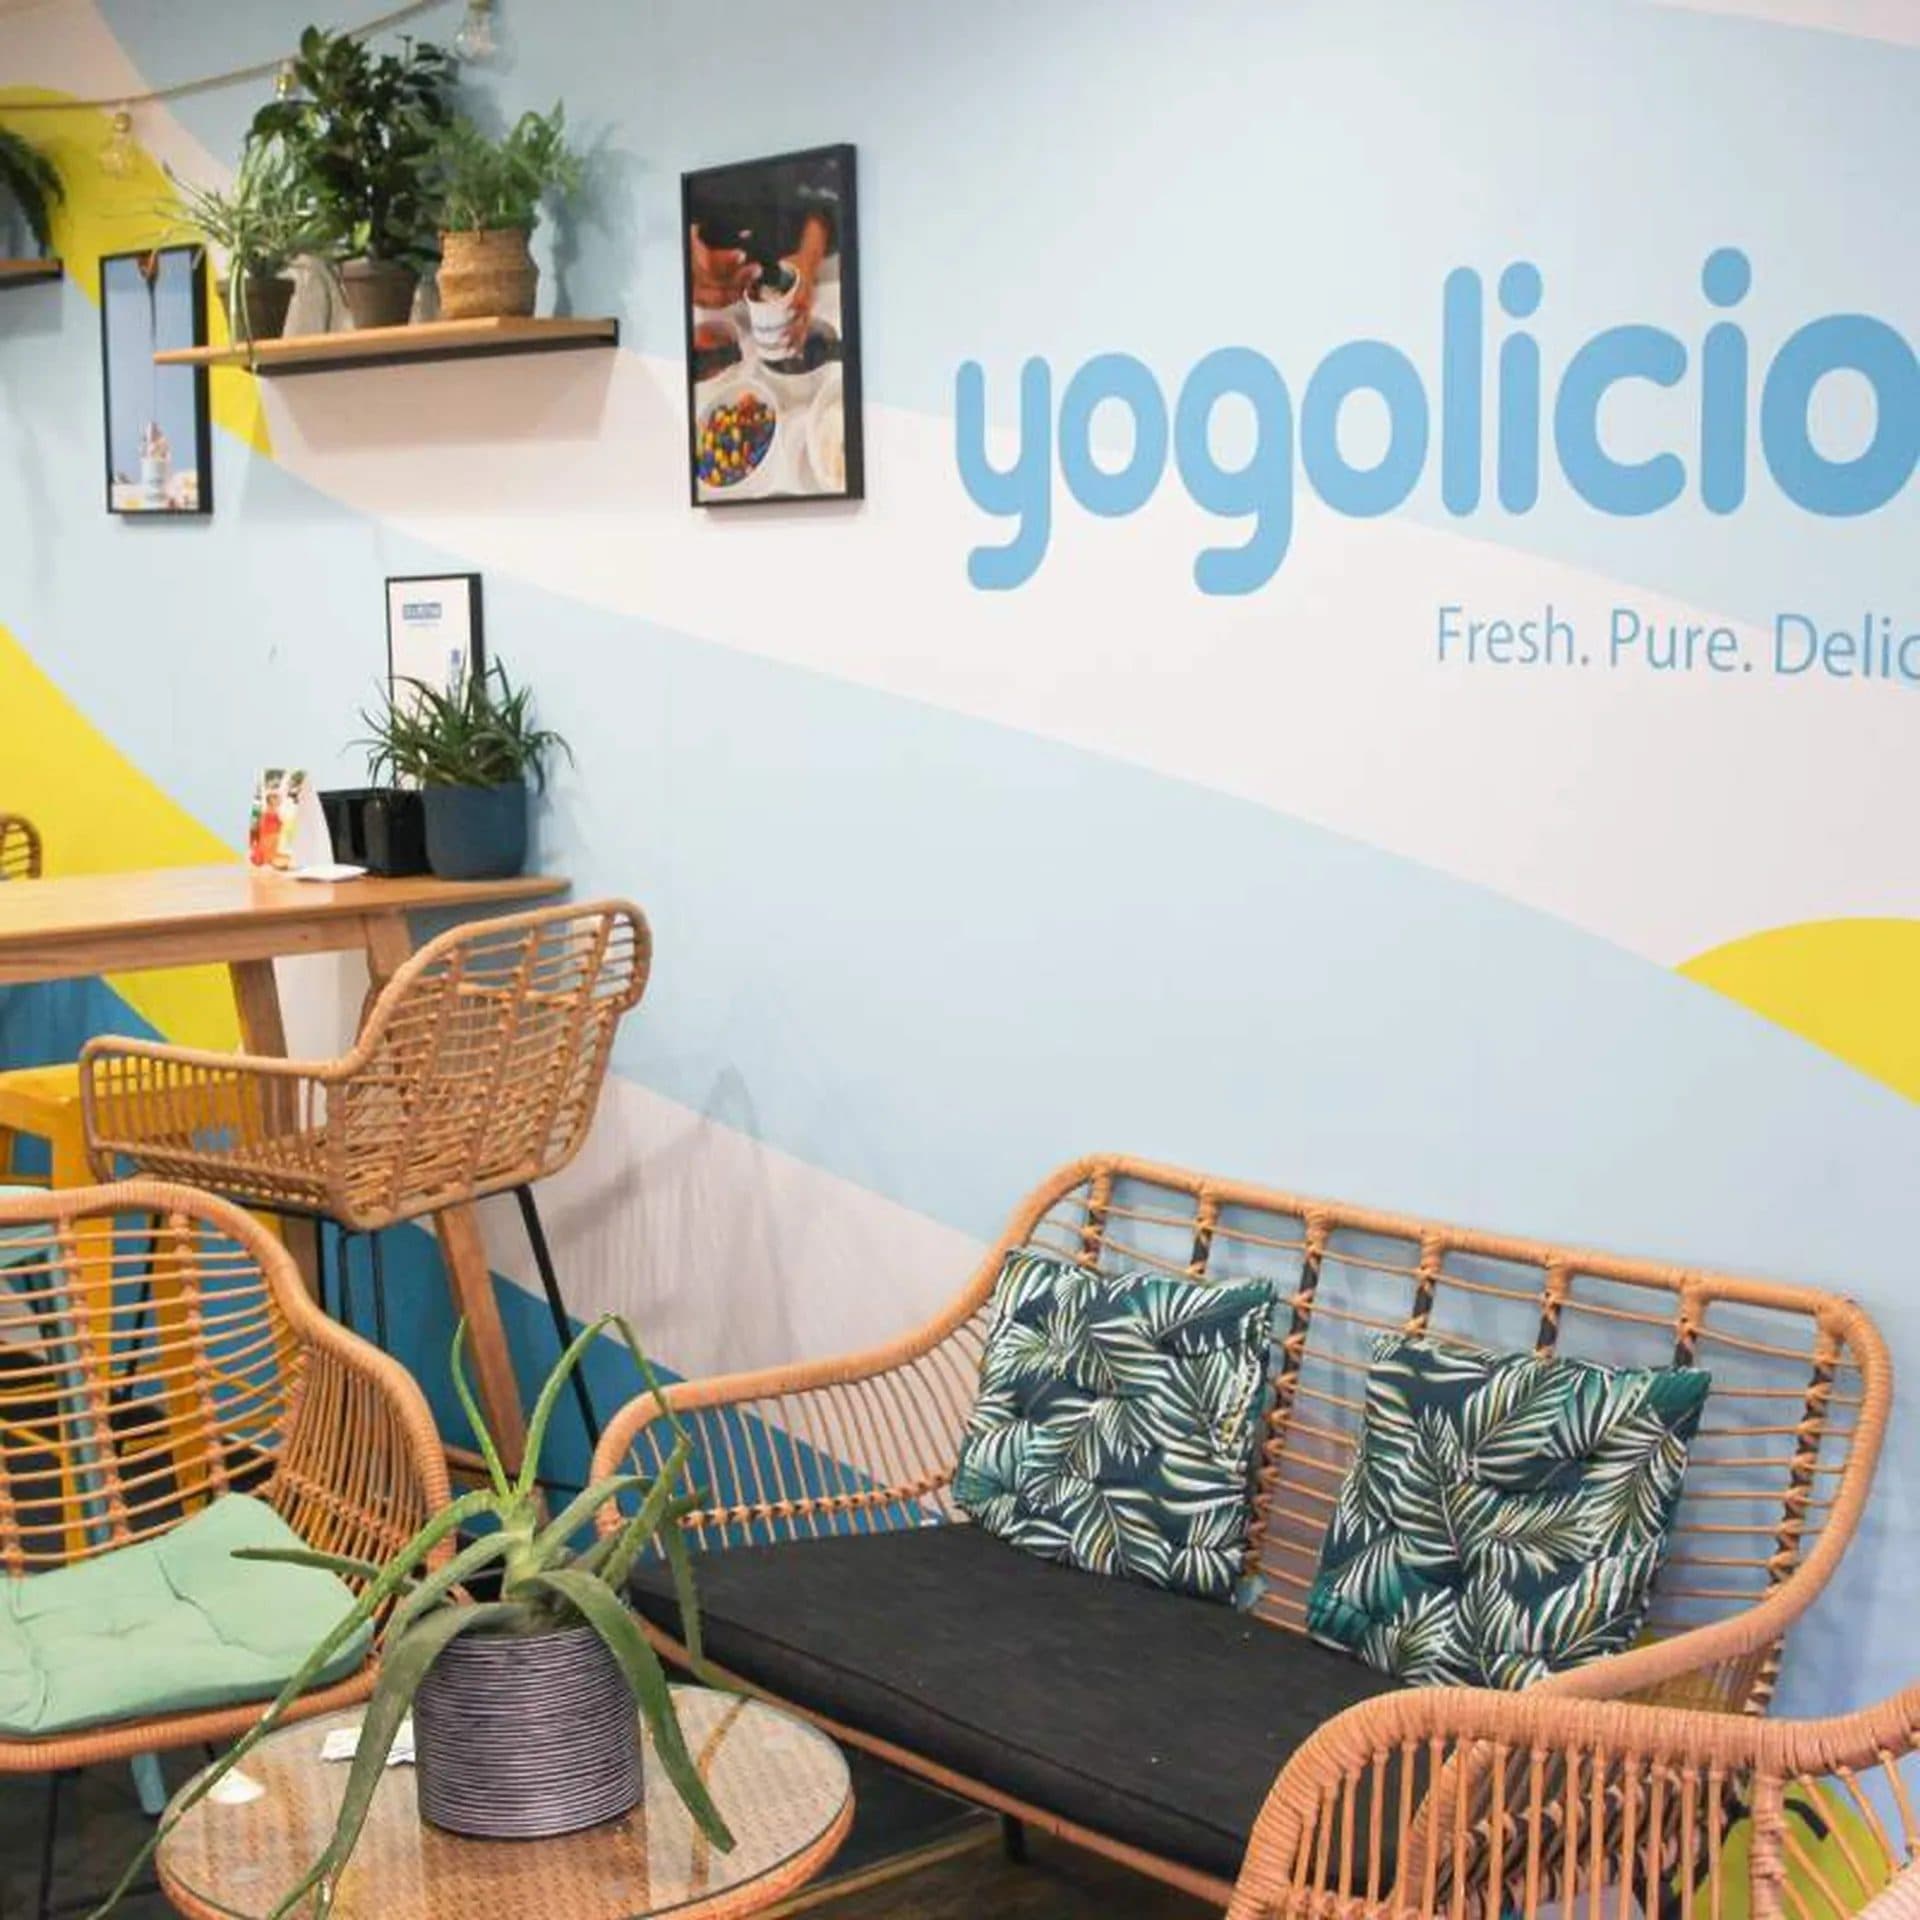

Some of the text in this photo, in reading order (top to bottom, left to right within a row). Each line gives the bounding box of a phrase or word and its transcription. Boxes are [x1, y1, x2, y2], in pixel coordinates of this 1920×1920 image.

[955, 247, 1920, 596] yogolicio
[1437, 604, 1920, 681] Fresh. Pure. Delic
